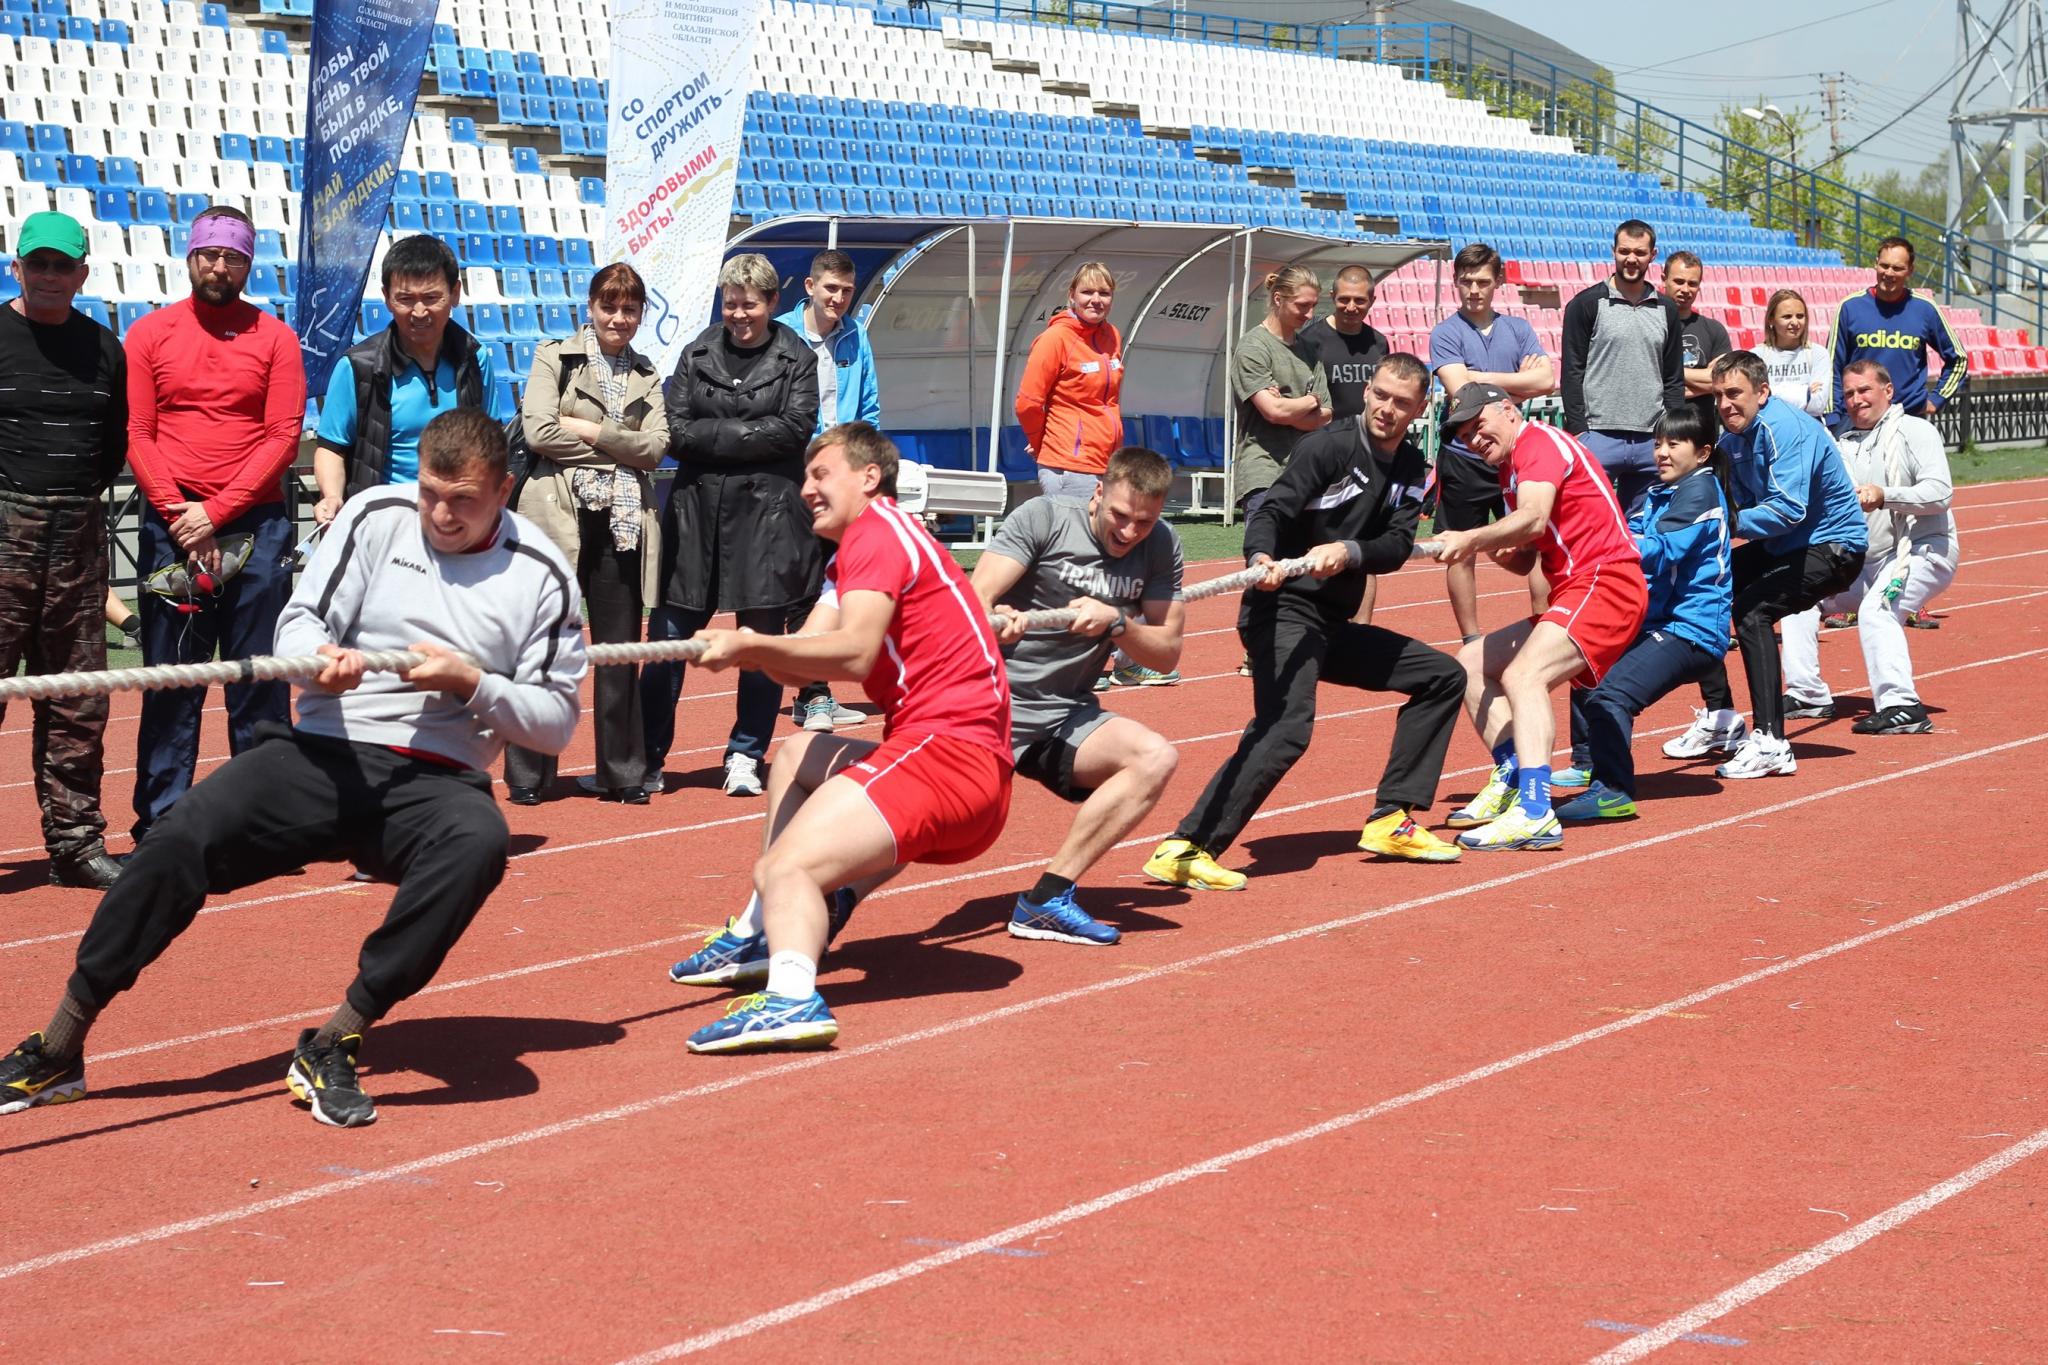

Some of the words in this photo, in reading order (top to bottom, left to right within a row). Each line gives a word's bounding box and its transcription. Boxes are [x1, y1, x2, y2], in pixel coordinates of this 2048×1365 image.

[664, 10, 713, 23] ПОЛИТИКИ
[674, 2, 738, 17] МОЛОДЕЖНОЙ
[672, 32, 712, 44] ОБЛАСТИ
[673, 23, 739, 38] САХАЛИНСКОЙ
[315, 80, 351, 126] ДЕНЬ
[350, 40, 390, 86] ТВОЙ
[320, 103, 355, 143] БЫЛ
[355, 94, 366, 114] В
[621, 98, 644, 122] СО
[636, 71, 710, 140] СПОРТОМ
[329, 94, 403, 164] ПОРЯДКЕ,
[650, 94, 722, 164] ДРУЖИТЬ
[321, 159, 395, 233] ЗАРЯДКИ!
[616, 144, 717, 234] ЗДОРОВЫМИ
[627, 207, 674, 256] БЫТЬ!
[1168, 302, 1211, 321] SELECT
[1856, 329, 1920, 350] adidas
[1331, 363, 1376, 383] ASIC
[1059, 560, 1144, 600] TRAINING
